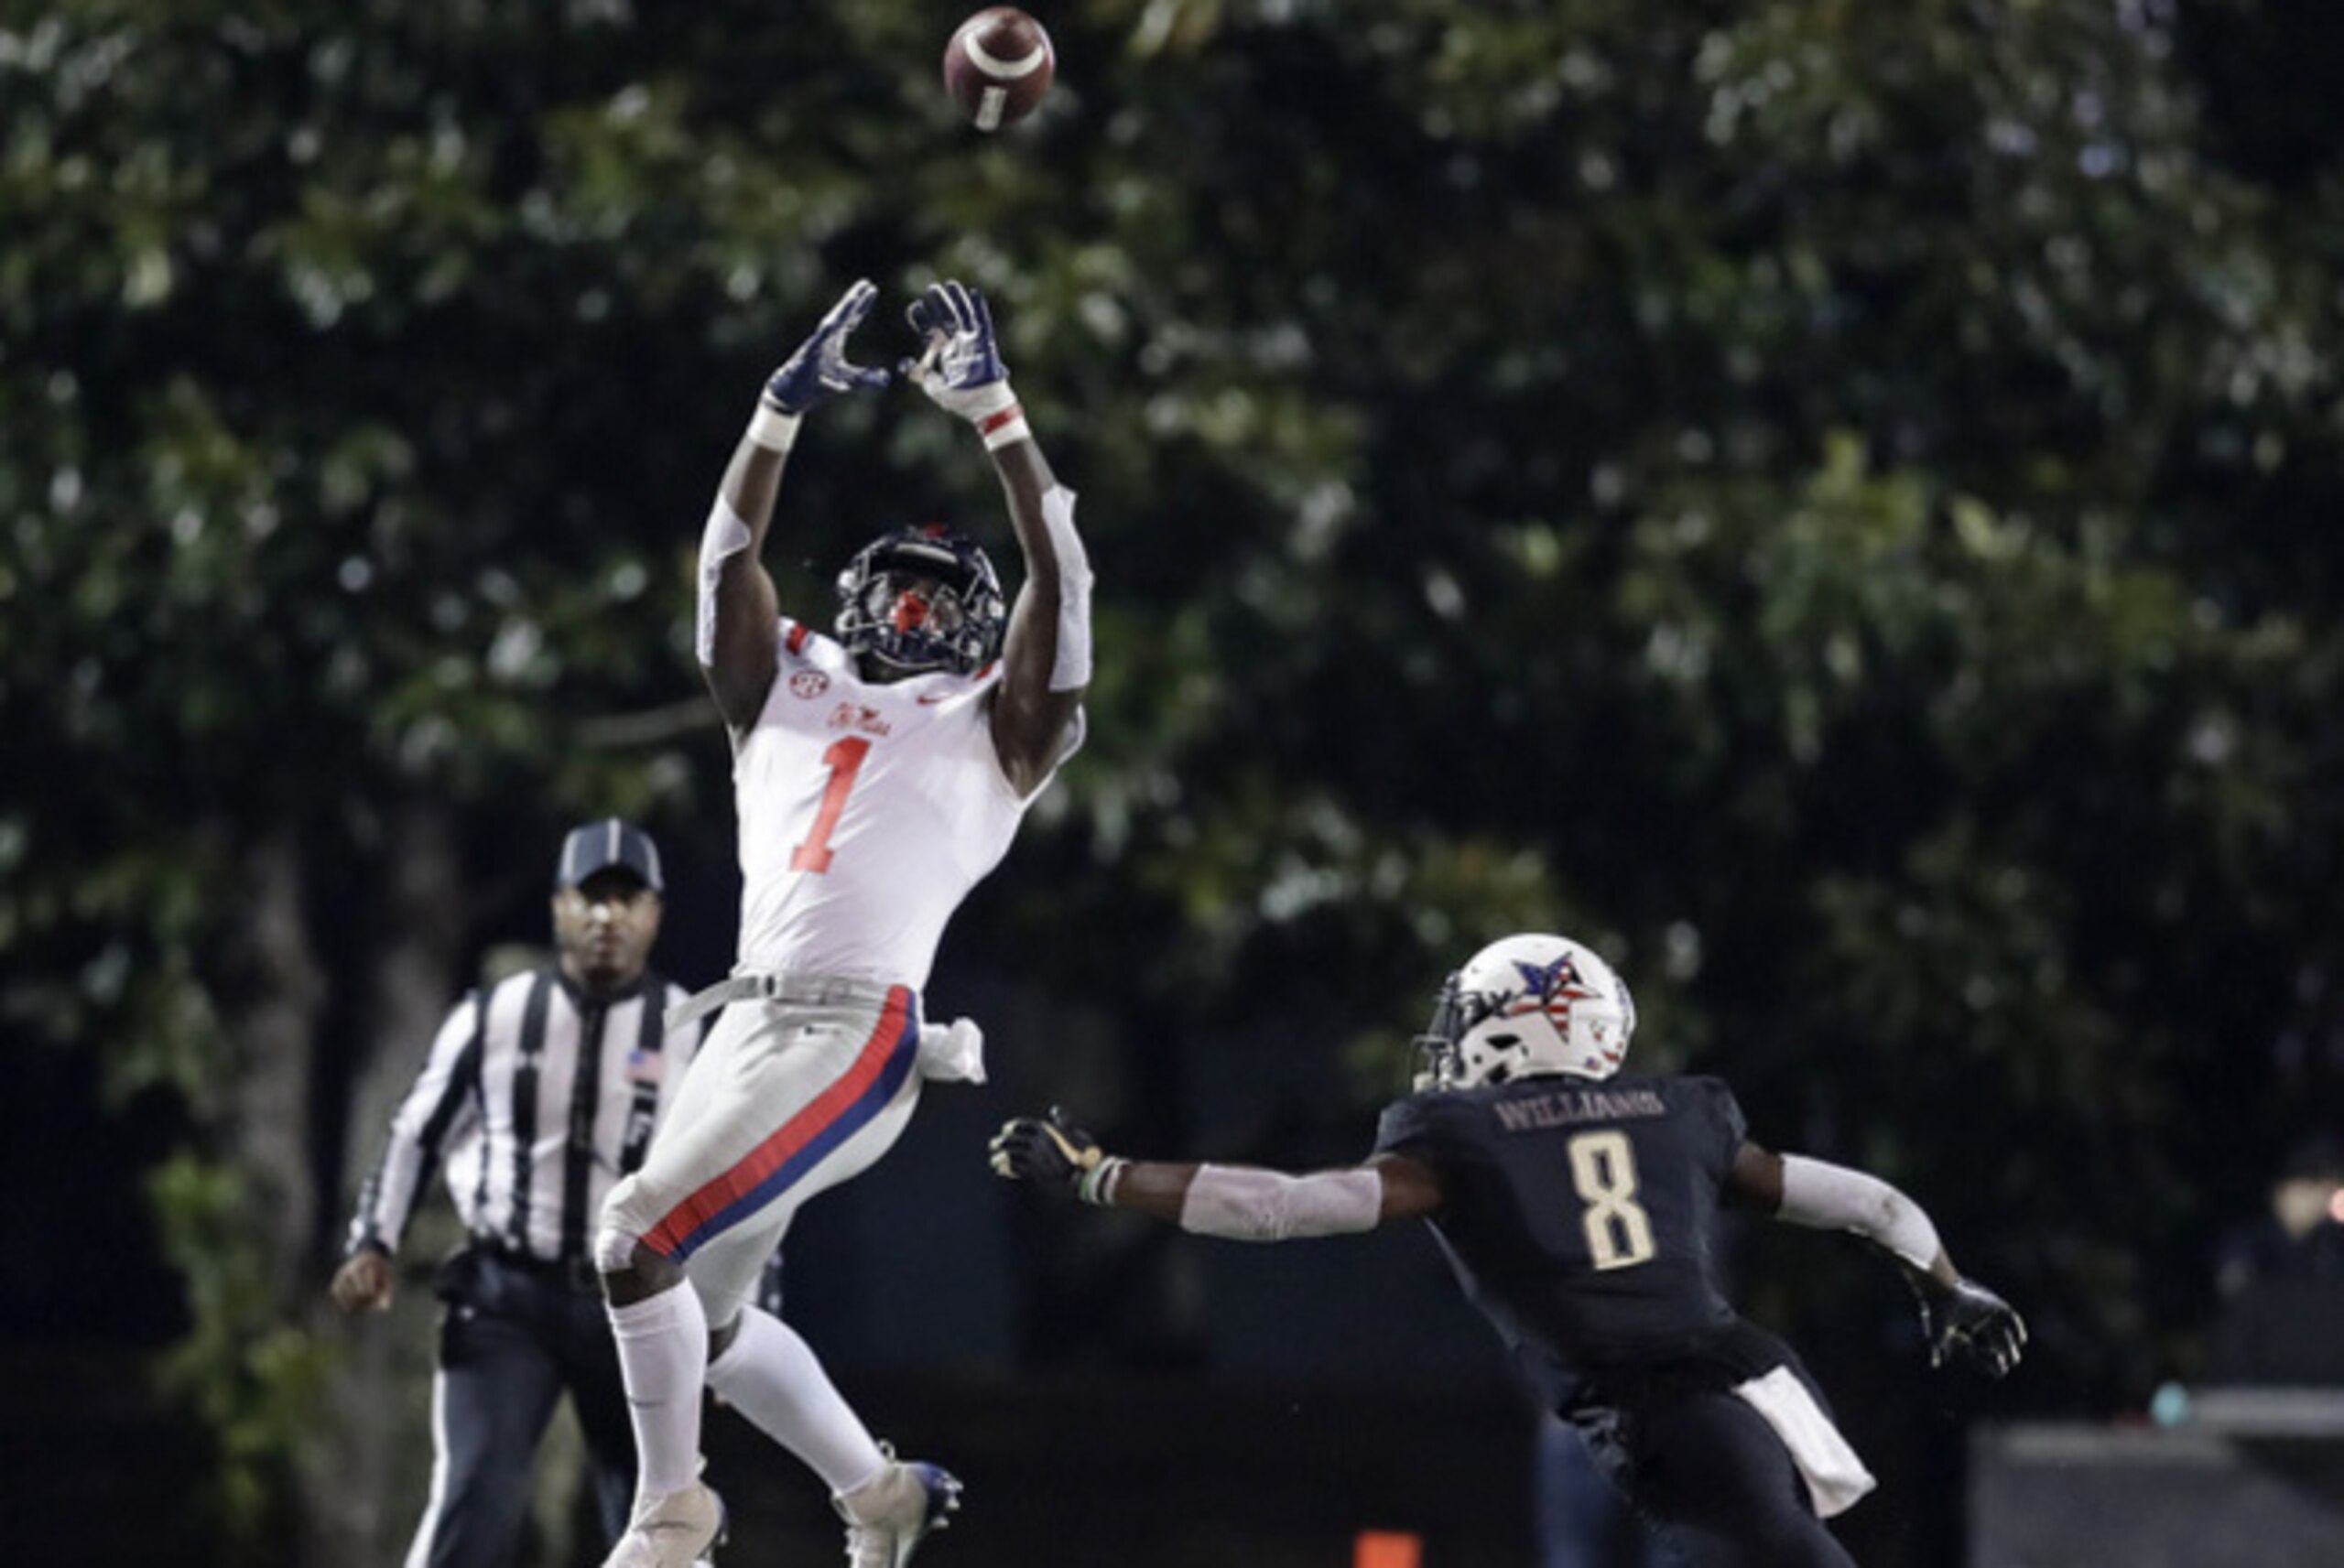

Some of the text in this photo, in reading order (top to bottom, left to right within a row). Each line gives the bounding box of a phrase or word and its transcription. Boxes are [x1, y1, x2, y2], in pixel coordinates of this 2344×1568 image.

[789, 735, 873, 875] 1
[1494, 1091, 1666, 1130] WILLIAMS
[1568, 1130, 1655, 1271] 8
